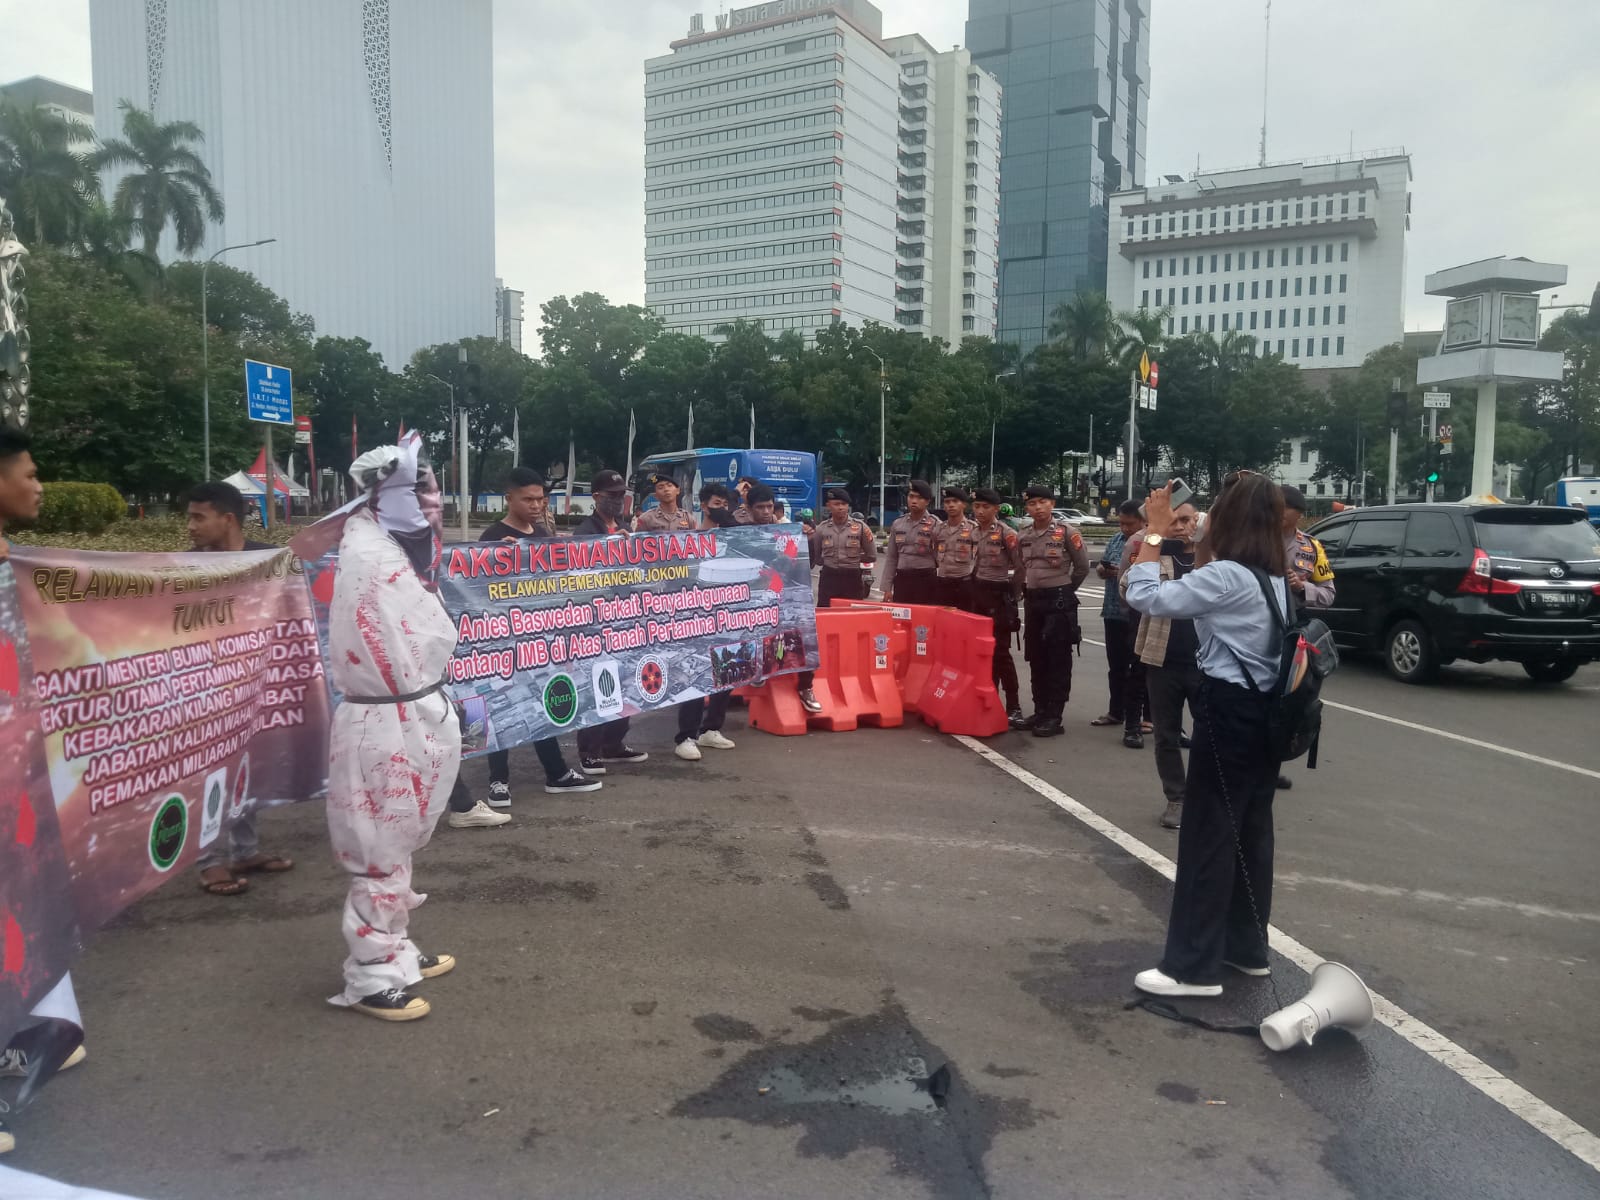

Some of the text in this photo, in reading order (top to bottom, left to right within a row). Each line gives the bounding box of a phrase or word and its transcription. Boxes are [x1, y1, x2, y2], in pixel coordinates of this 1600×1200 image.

[715, 6, 767, 30] wisma
[448, 532, 718, 579] AKSI KEMANUSIAAN
[488, 564, 689, 602] RELAWAN PEMENANGAN JOKOWI
[33, 566, 154, 603] RELAWAN
[172, 596, 235, 634] TUNTUT
[458, 583, 749, 643] Anies Baswedan Terkait Penyalahgunaan
[517, 639, 548, 669] IMB
[551, 633, 566, 662] di
[568, 633, 601, 660] Atas
[603, 621, 646, 651] Tanah
[647, 613, 715, 644] Pertamina
[716, 605, 779, 633] Plumpang
[35, 666, 101, 699] GANTI
[106, 650, 170, 686] MENTERI
[172, 641, 217, 668] BUMN,
[115, 680, 170, 714] UTAMA
[171, 661, 246, 698] PERTAMINA
[65, 703, 182, 759] KEBAKARAN
[184, 690, 232, 722] KILANG
[85, 736, 169, 782] JABATAN
[173, 719, 220, 753] KALIAN
[90, 760, 179, 813] PEMAKAN
[183, 735, 238, 776] MILIARAN
